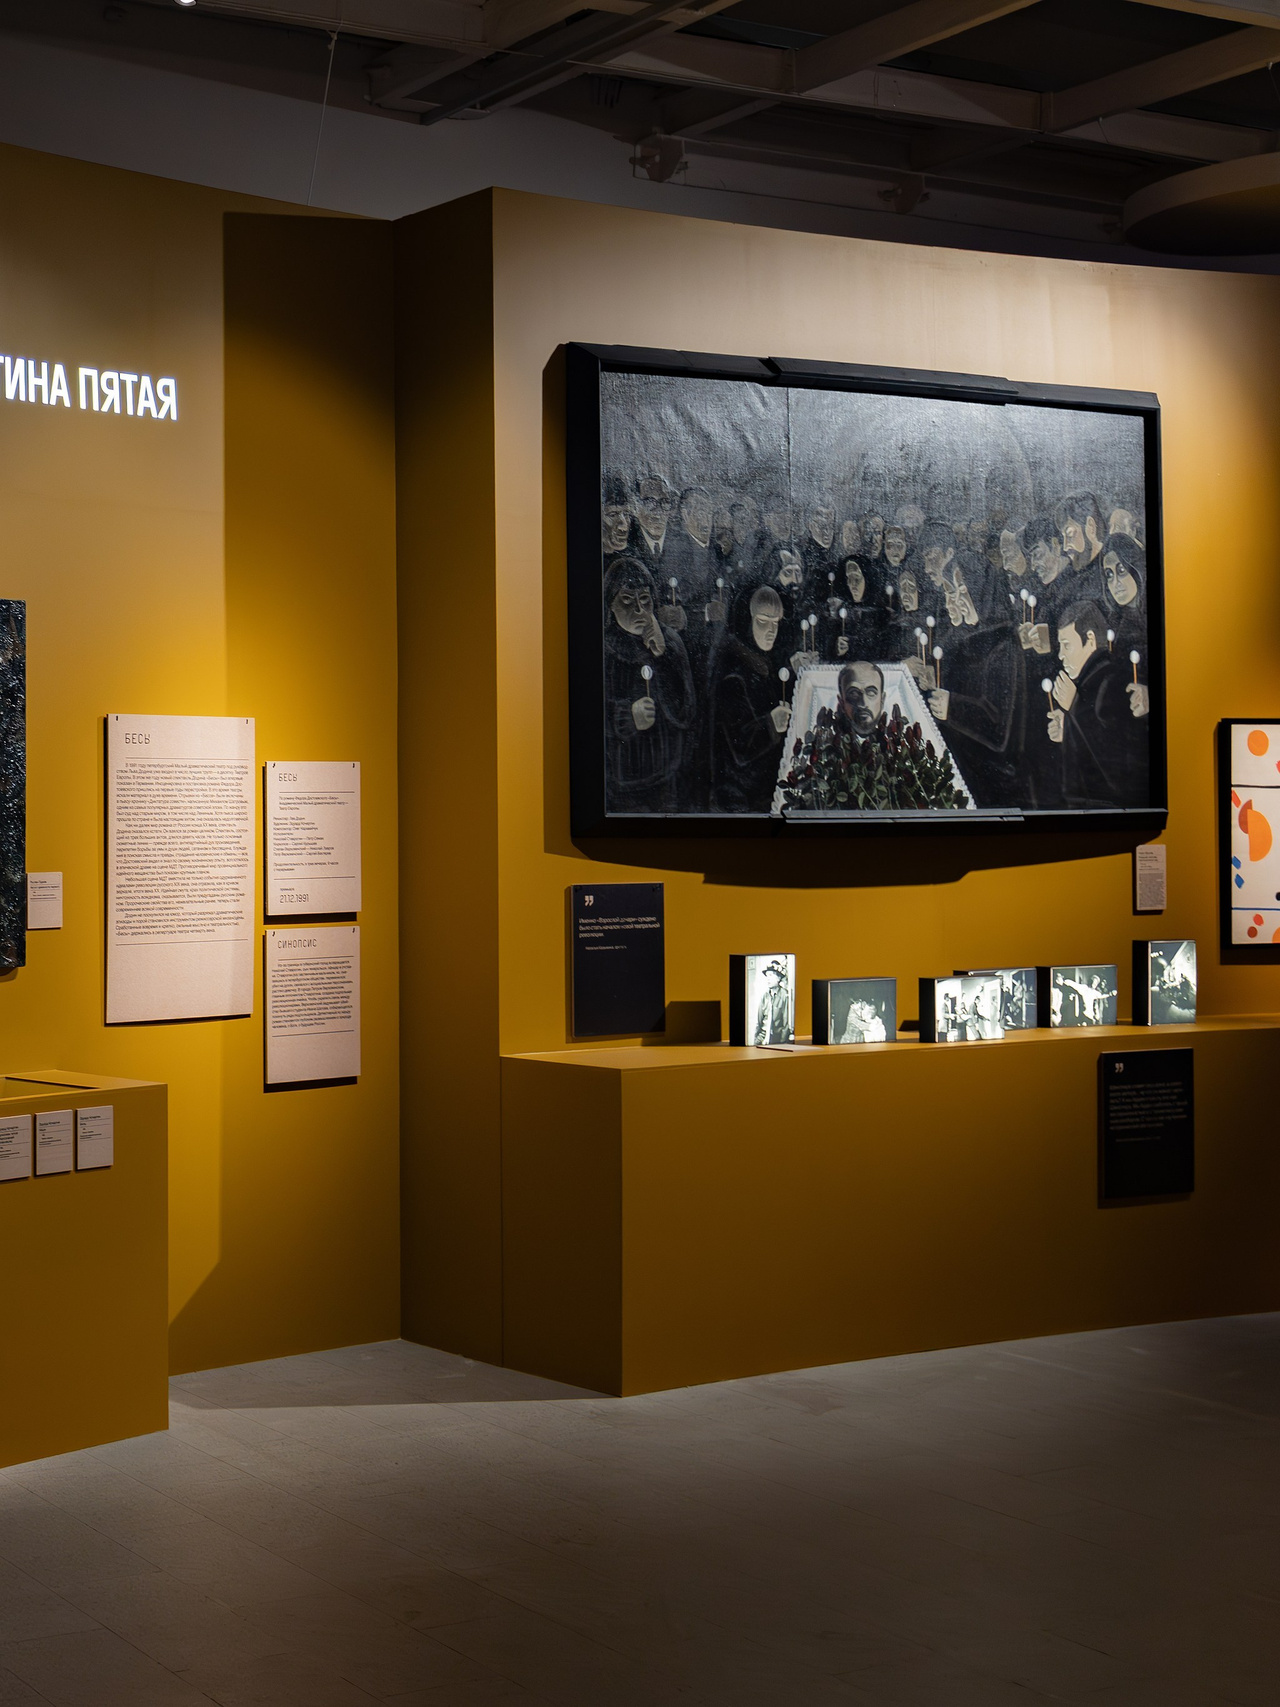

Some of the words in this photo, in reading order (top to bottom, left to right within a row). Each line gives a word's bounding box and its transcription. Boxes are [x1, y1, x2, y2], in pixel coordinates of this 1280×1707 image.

[78, 367, 178, 421] ПЯТАЯ
[124, 733, 151, 745] БЕСЫ
[278, 772, 298, 782] БЕСЫ
[279, 894, 310, 904] 21.12.1991
[277, 938, 318, 948] СИНОПСИС
